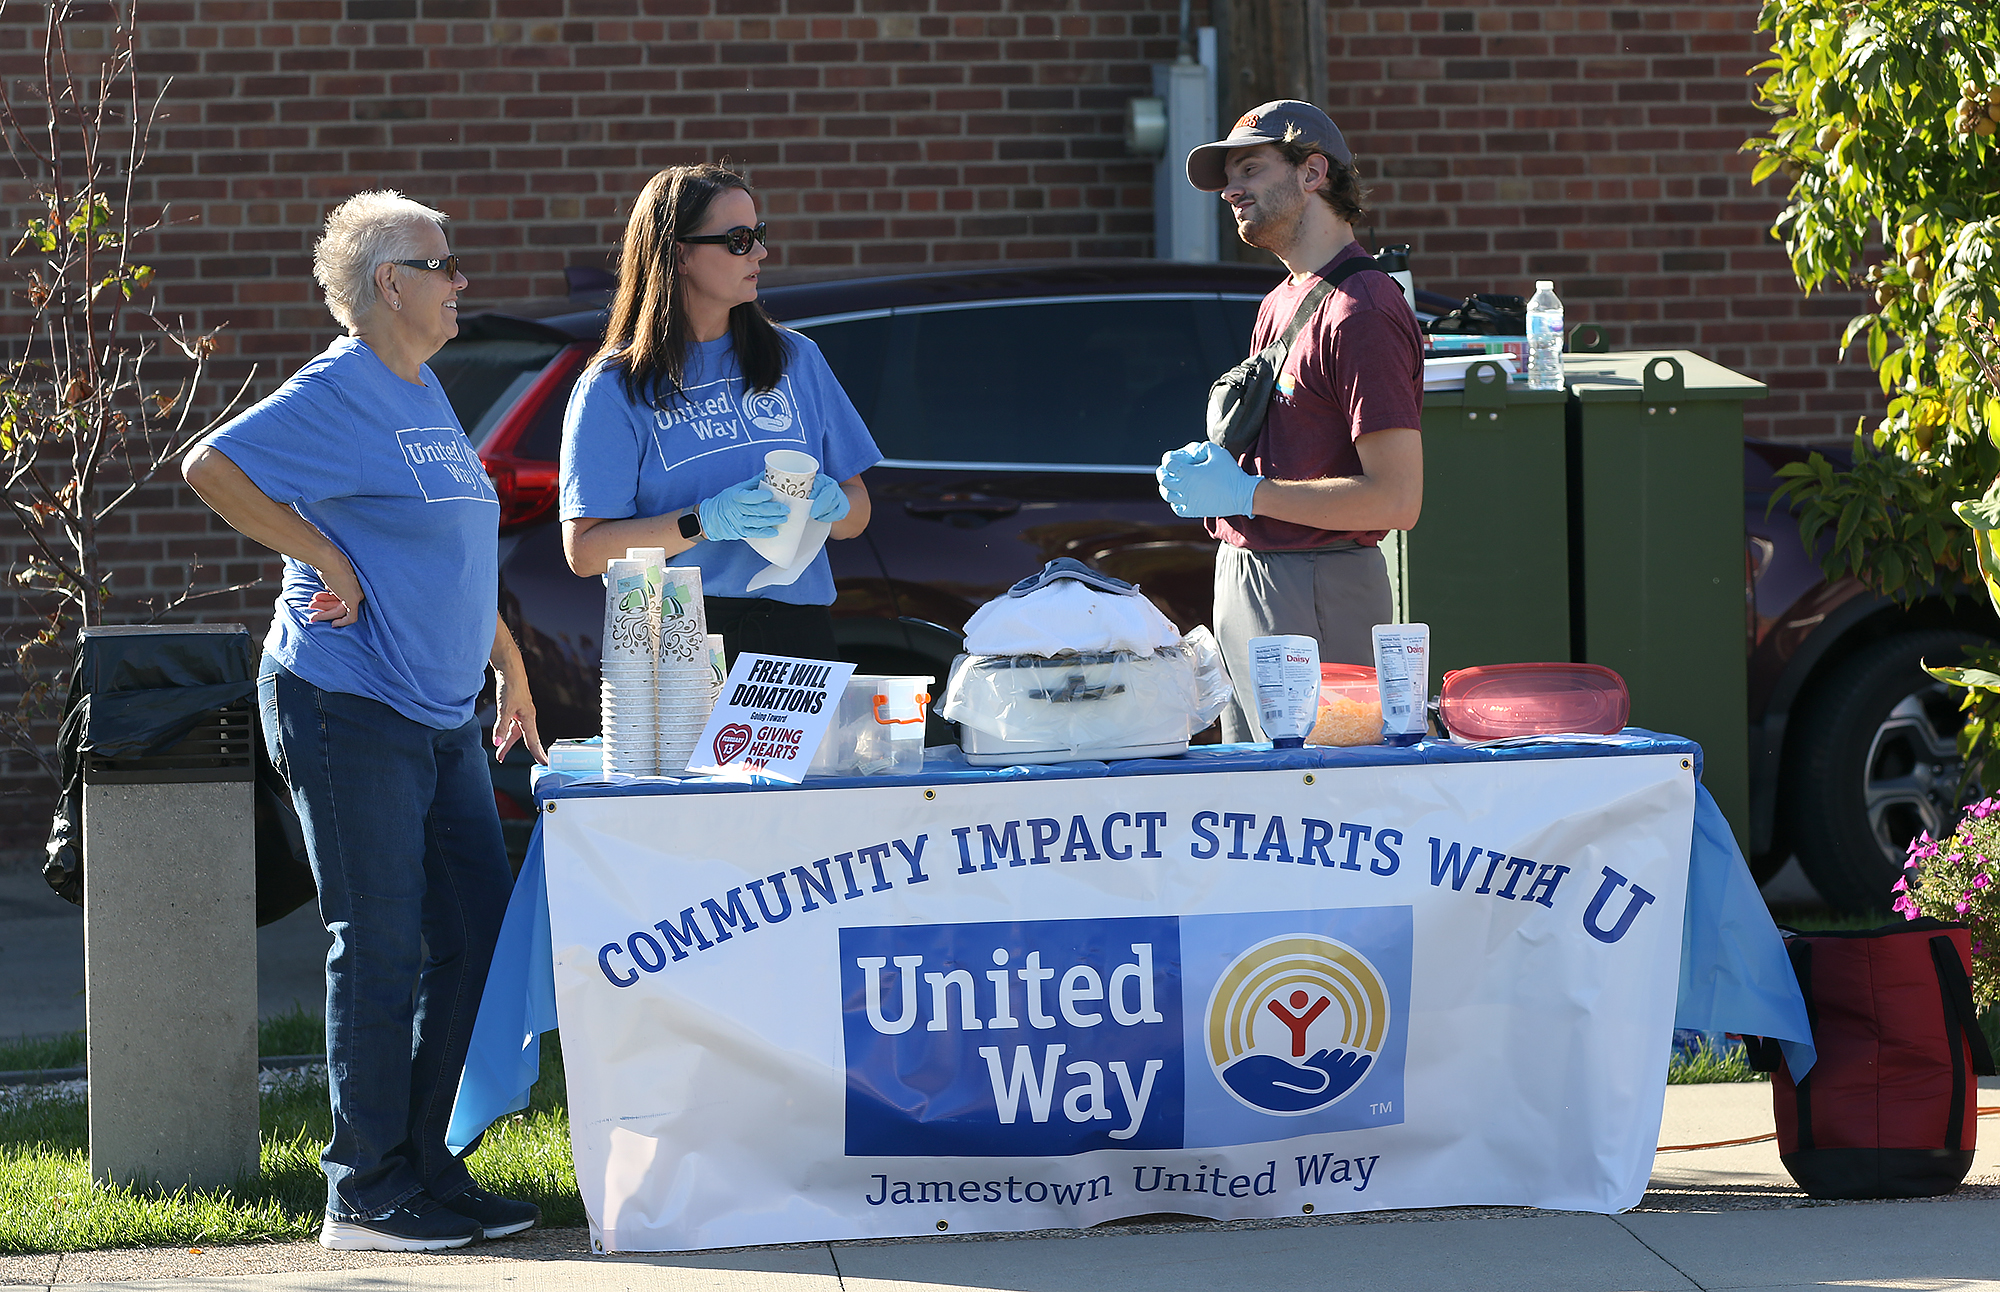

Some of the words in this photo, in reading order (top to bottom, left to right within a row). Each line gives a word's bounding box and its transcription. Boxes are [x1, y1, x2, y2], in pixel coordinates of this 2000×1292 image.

[654, 392, 733, 431] United
[690, 418, 738, 441] Way
[405, 440, 464, 465] United
[443, 463, 477, 491] Way
[1286, 653, 1310, 665] Daisy
[748, 659, 792, 685] FREE
[788, 663, 831, 688] WILL
[729, 683, 828, 715] DONATIONS
[750, 711, 768, 723] Going
[767, 713, 788, 723] Toward
[756, 726, 804, 745] GIVING
[722, 743, 736, 755] 13
[748, 741, 799, 761] HEARTS
[742, 757, 770, 772] DAY
[597, 832, 930, 989] COMMUNITY
[950, 810, 1168, 876] IMPACT
[1190, 810, 1404, 878] STARTS
[1427, 835, 1571, 910] WITH
[1581, 864, 1657, 945] U
[855, 942, 1164, 1036] United
[978, 1043, 1164, 1140] Way
[1369, 1102, 1393, 1116] TM
[865, 1173, 1113, 1206] Jamestown
[1132, 1161, 1278, 1199] United
[1294, 1152, 1381, 1193] Way
